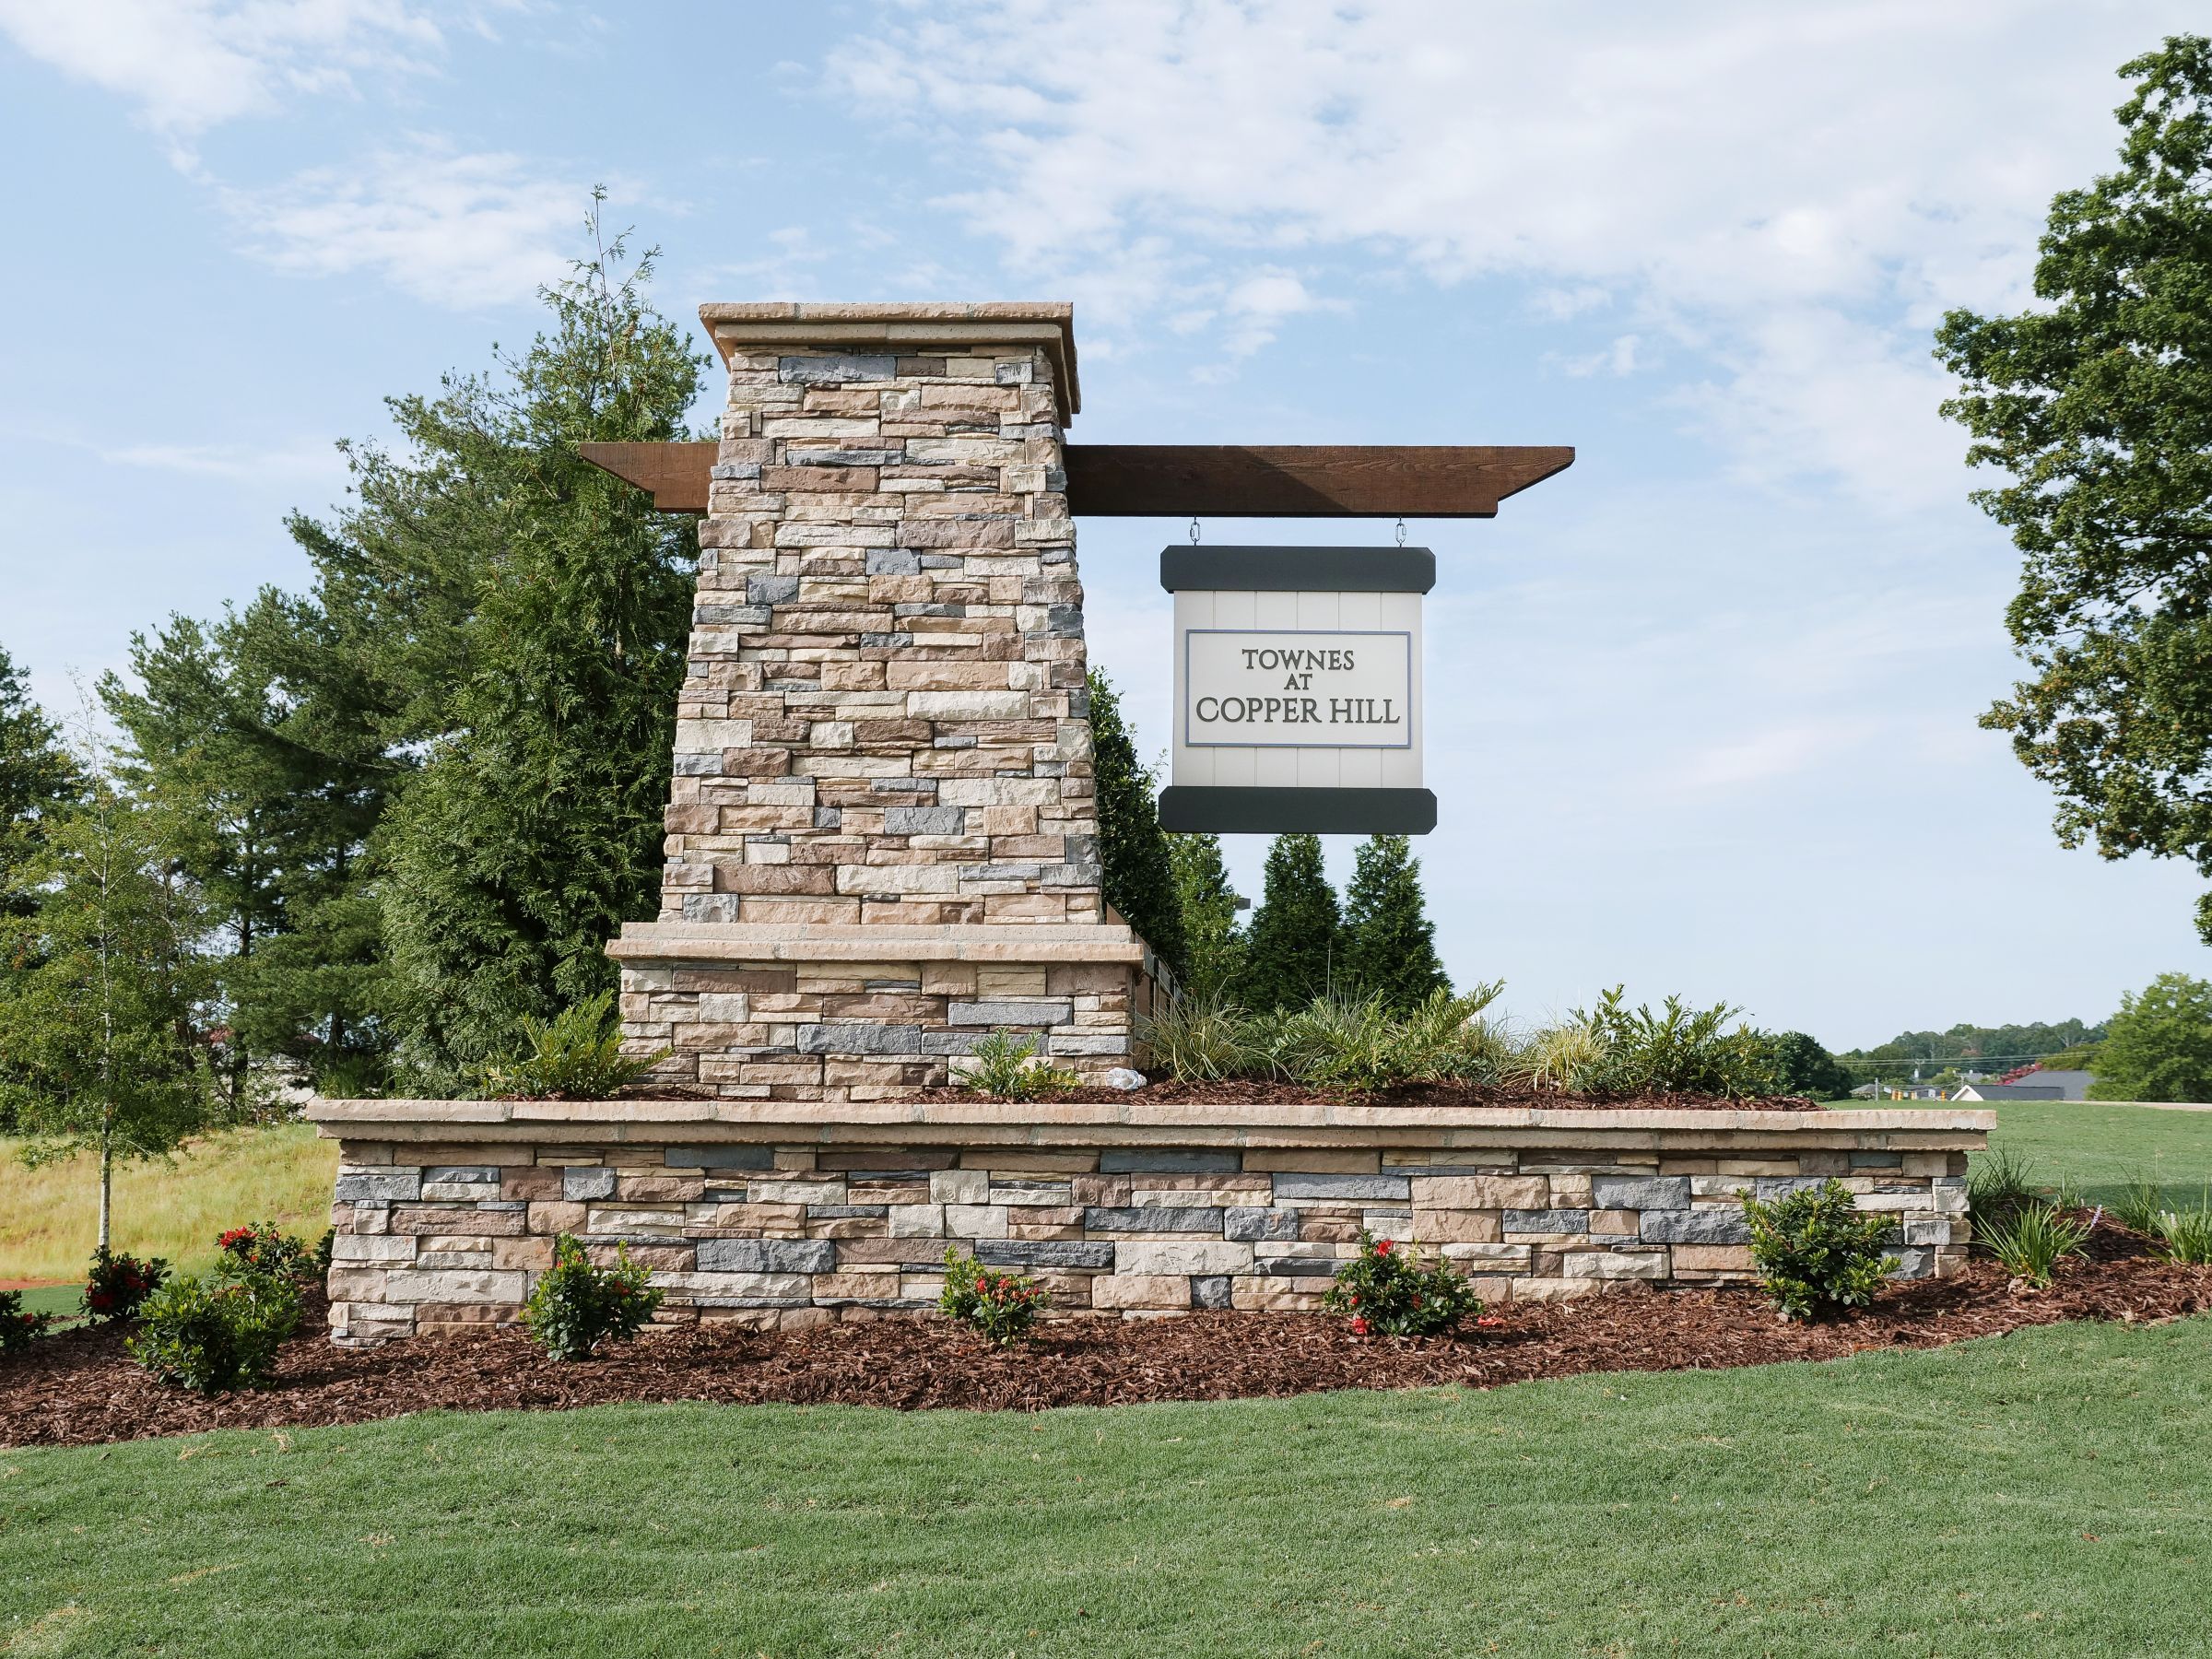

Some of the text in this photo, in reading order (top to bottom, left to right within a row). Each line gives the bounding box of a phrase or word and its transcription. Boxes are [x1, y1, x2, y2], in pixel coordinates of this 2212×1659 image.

[1241, 649, 1355, 670] TOWNES
[1283, 673, 1313, 690] AT
[1195, 697, 1401, 724] COPPER HILL
